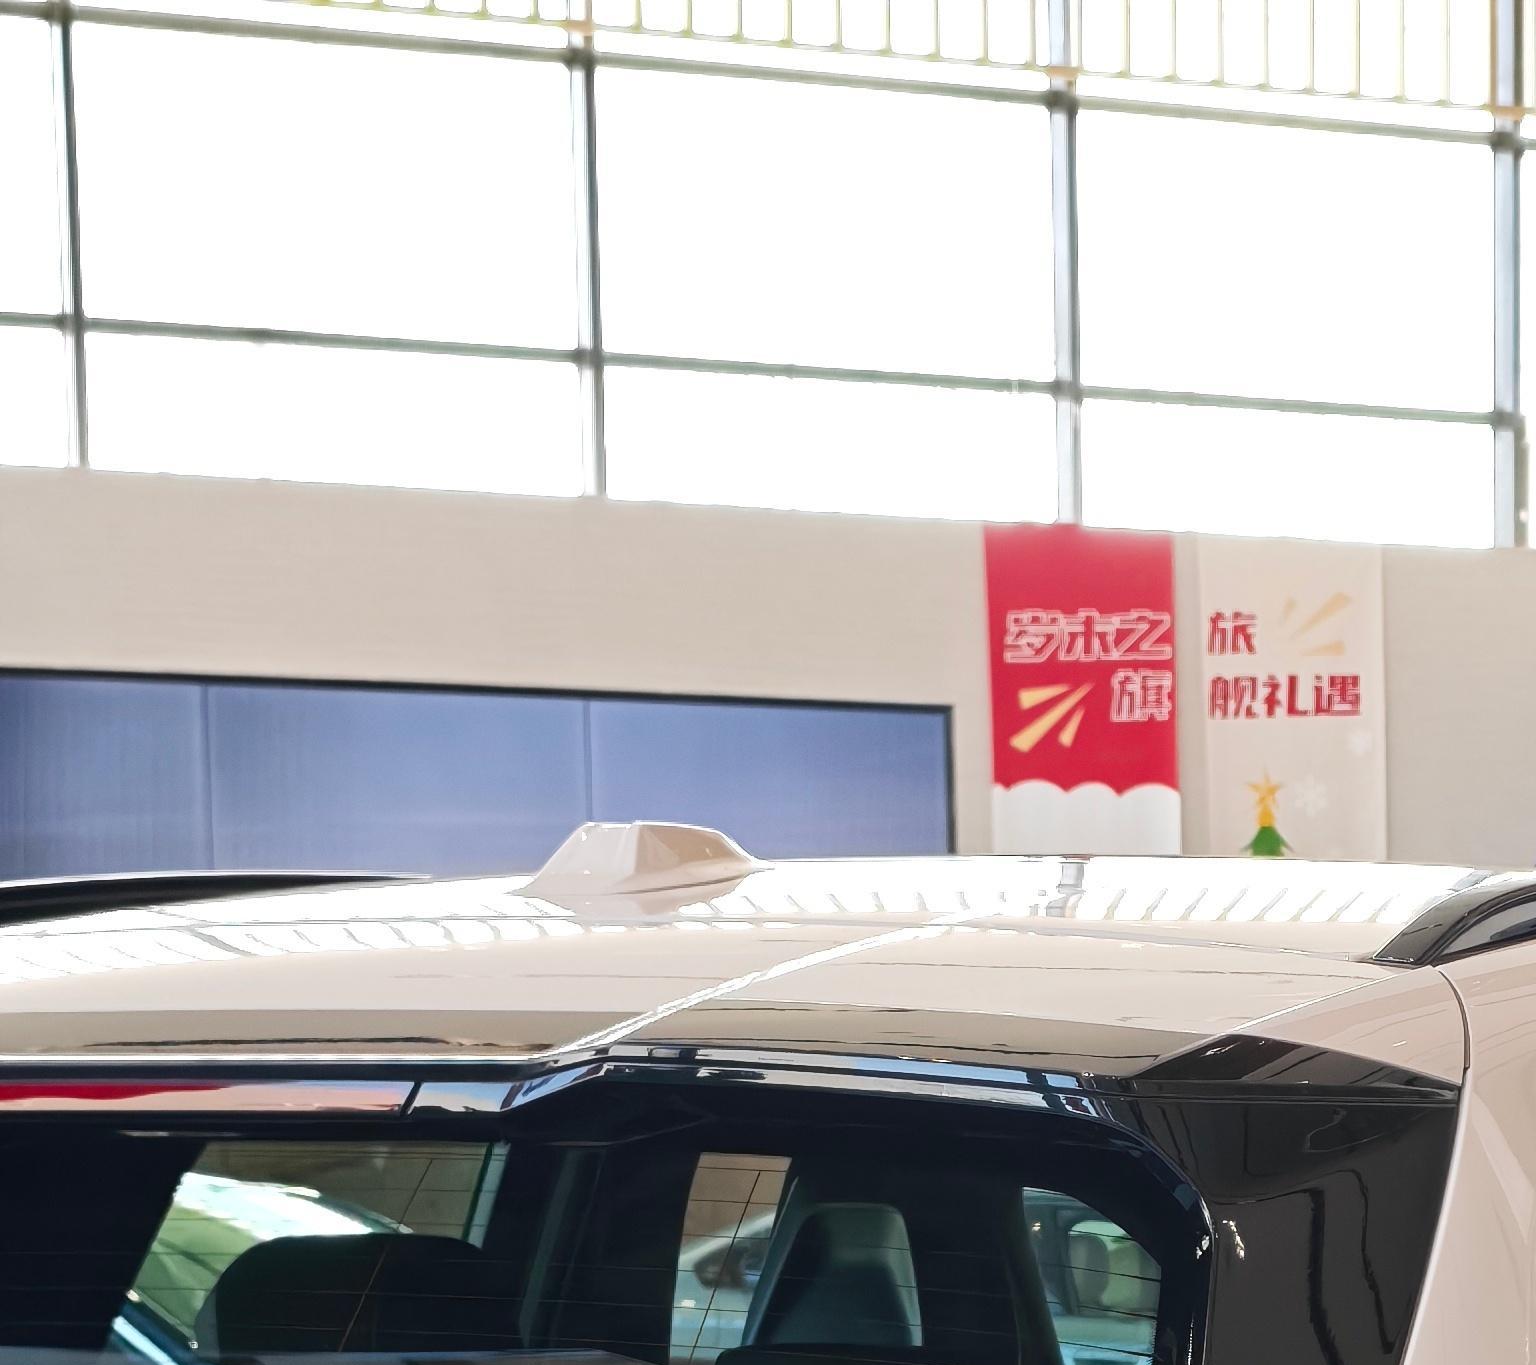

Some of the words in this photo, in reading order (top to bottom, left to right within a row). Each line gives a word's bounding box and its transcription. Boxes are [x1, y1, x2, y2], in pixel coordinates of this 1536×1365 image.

[1206, 611, 1257, 656] 旅
[1110, 667, 1173, 723] 旗
[1207, 673, 1361, 720] 舰礼遇
